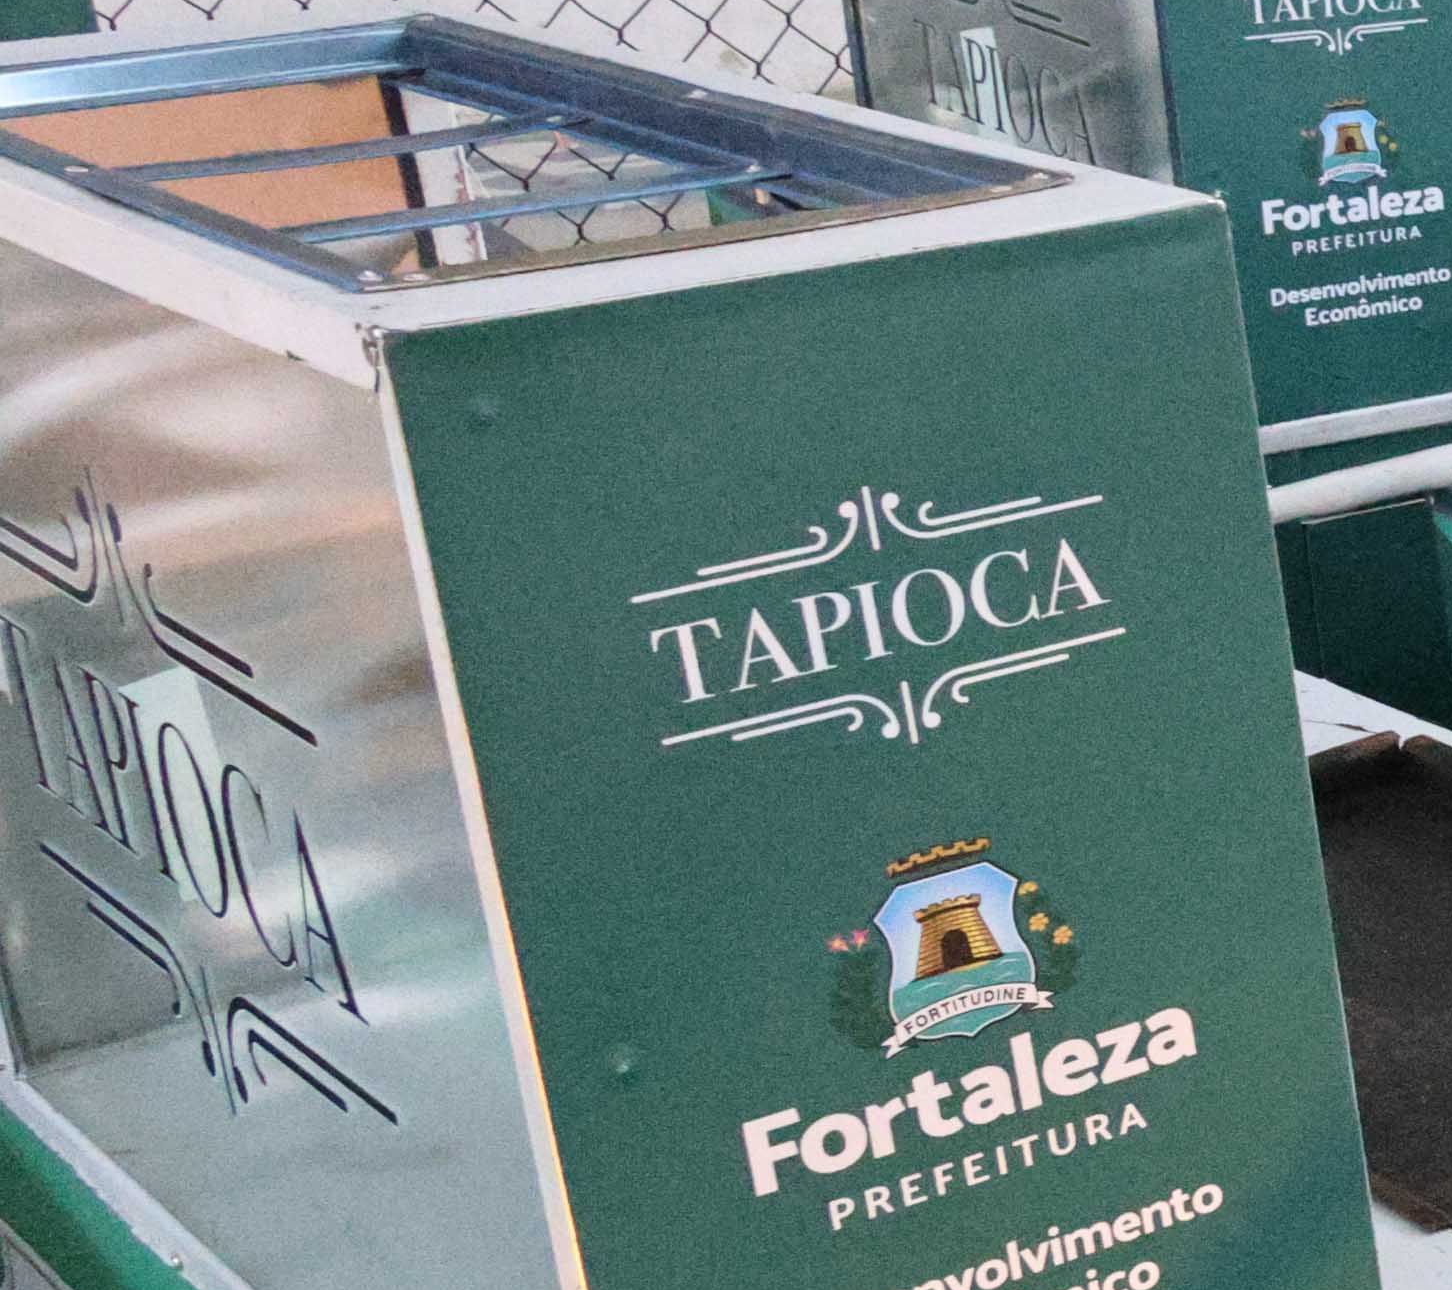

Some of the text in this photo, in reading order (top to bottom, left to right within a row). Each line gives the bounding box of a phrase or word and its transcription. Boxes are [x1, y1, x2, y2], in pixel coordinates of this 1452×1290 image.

[913, 17, 1096, 166] TAPIOCA
[1261, 185, 1445, 236] Fortaleza
[1291, 225, 1423, 257] PREFEITURA
[1270, 266, 1451, 307] Desenvolvimento
[1304, 295, 1423, 327] Econômico
[651, 538, 1112, 704] TAPIOCA
[903, 986, 1028, 1036] FORTITUDINE
[740, 1007, 1198, 1197] Fortaleza
[828, 1102, 1149, 1231] PREFEITURA
